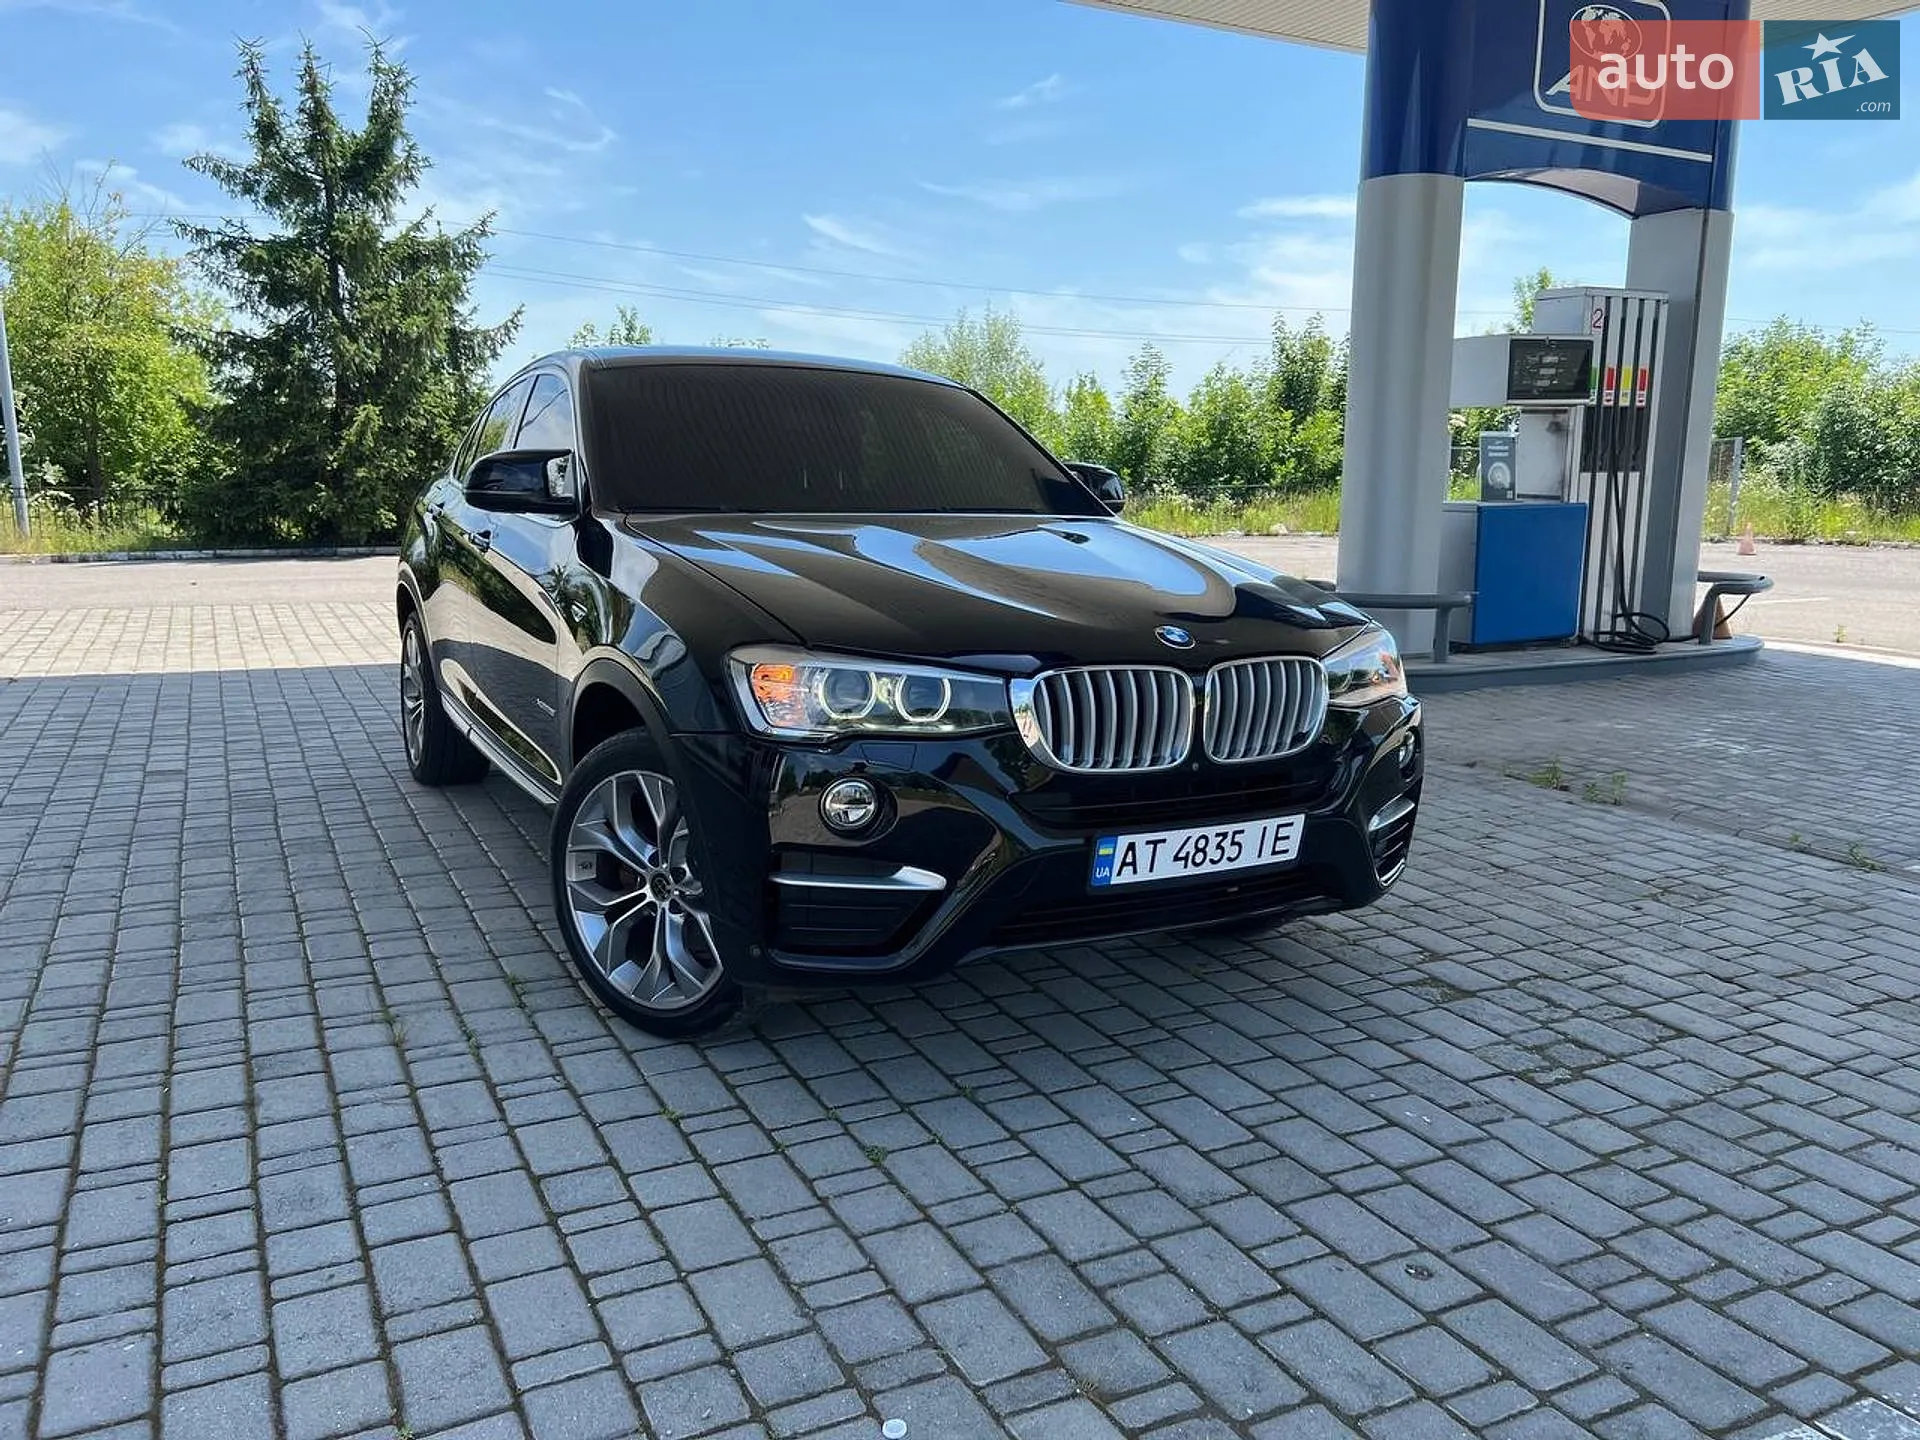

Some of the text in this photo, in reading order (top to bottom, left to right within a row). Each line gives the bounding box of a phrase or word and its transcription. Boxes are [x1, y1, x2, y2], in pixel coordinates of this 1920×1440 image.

[1592, 308, 1603, 329] 2
[1116, 821, 1294, 877] AT 4835 IE
[1095, 866, 1110, 879] UA
